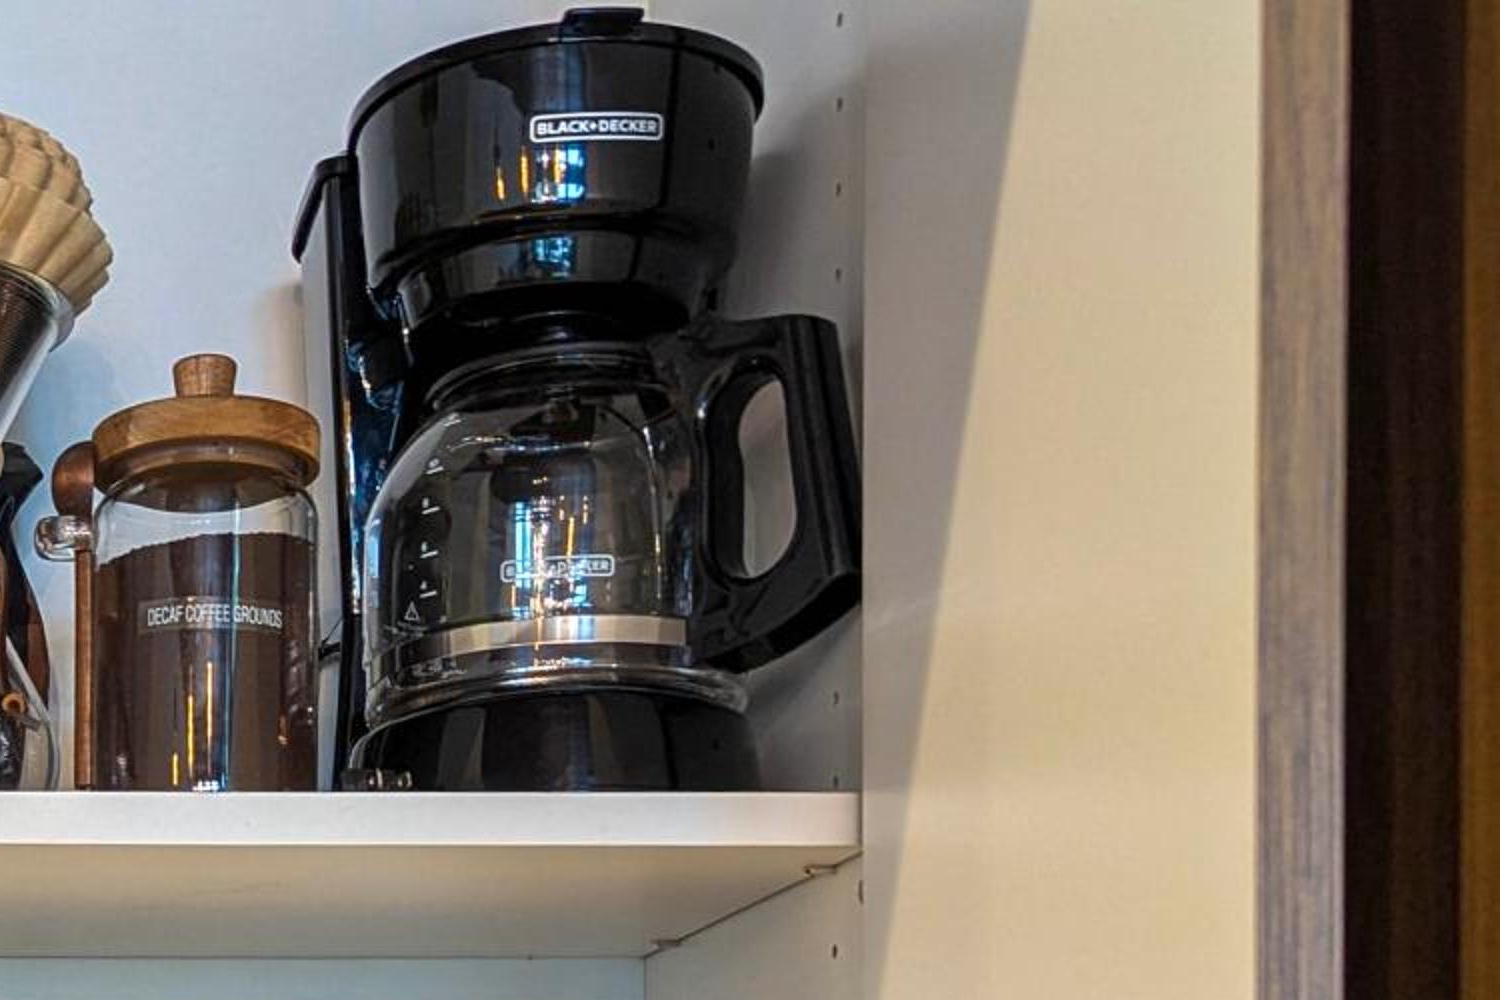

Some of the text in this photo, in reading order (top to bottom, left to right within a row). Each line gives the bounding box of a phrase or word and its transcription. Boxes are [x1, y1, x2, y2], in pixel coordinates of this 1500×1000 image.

[147, 602, 283, 629] DECAF COFFEE GROUNDS
